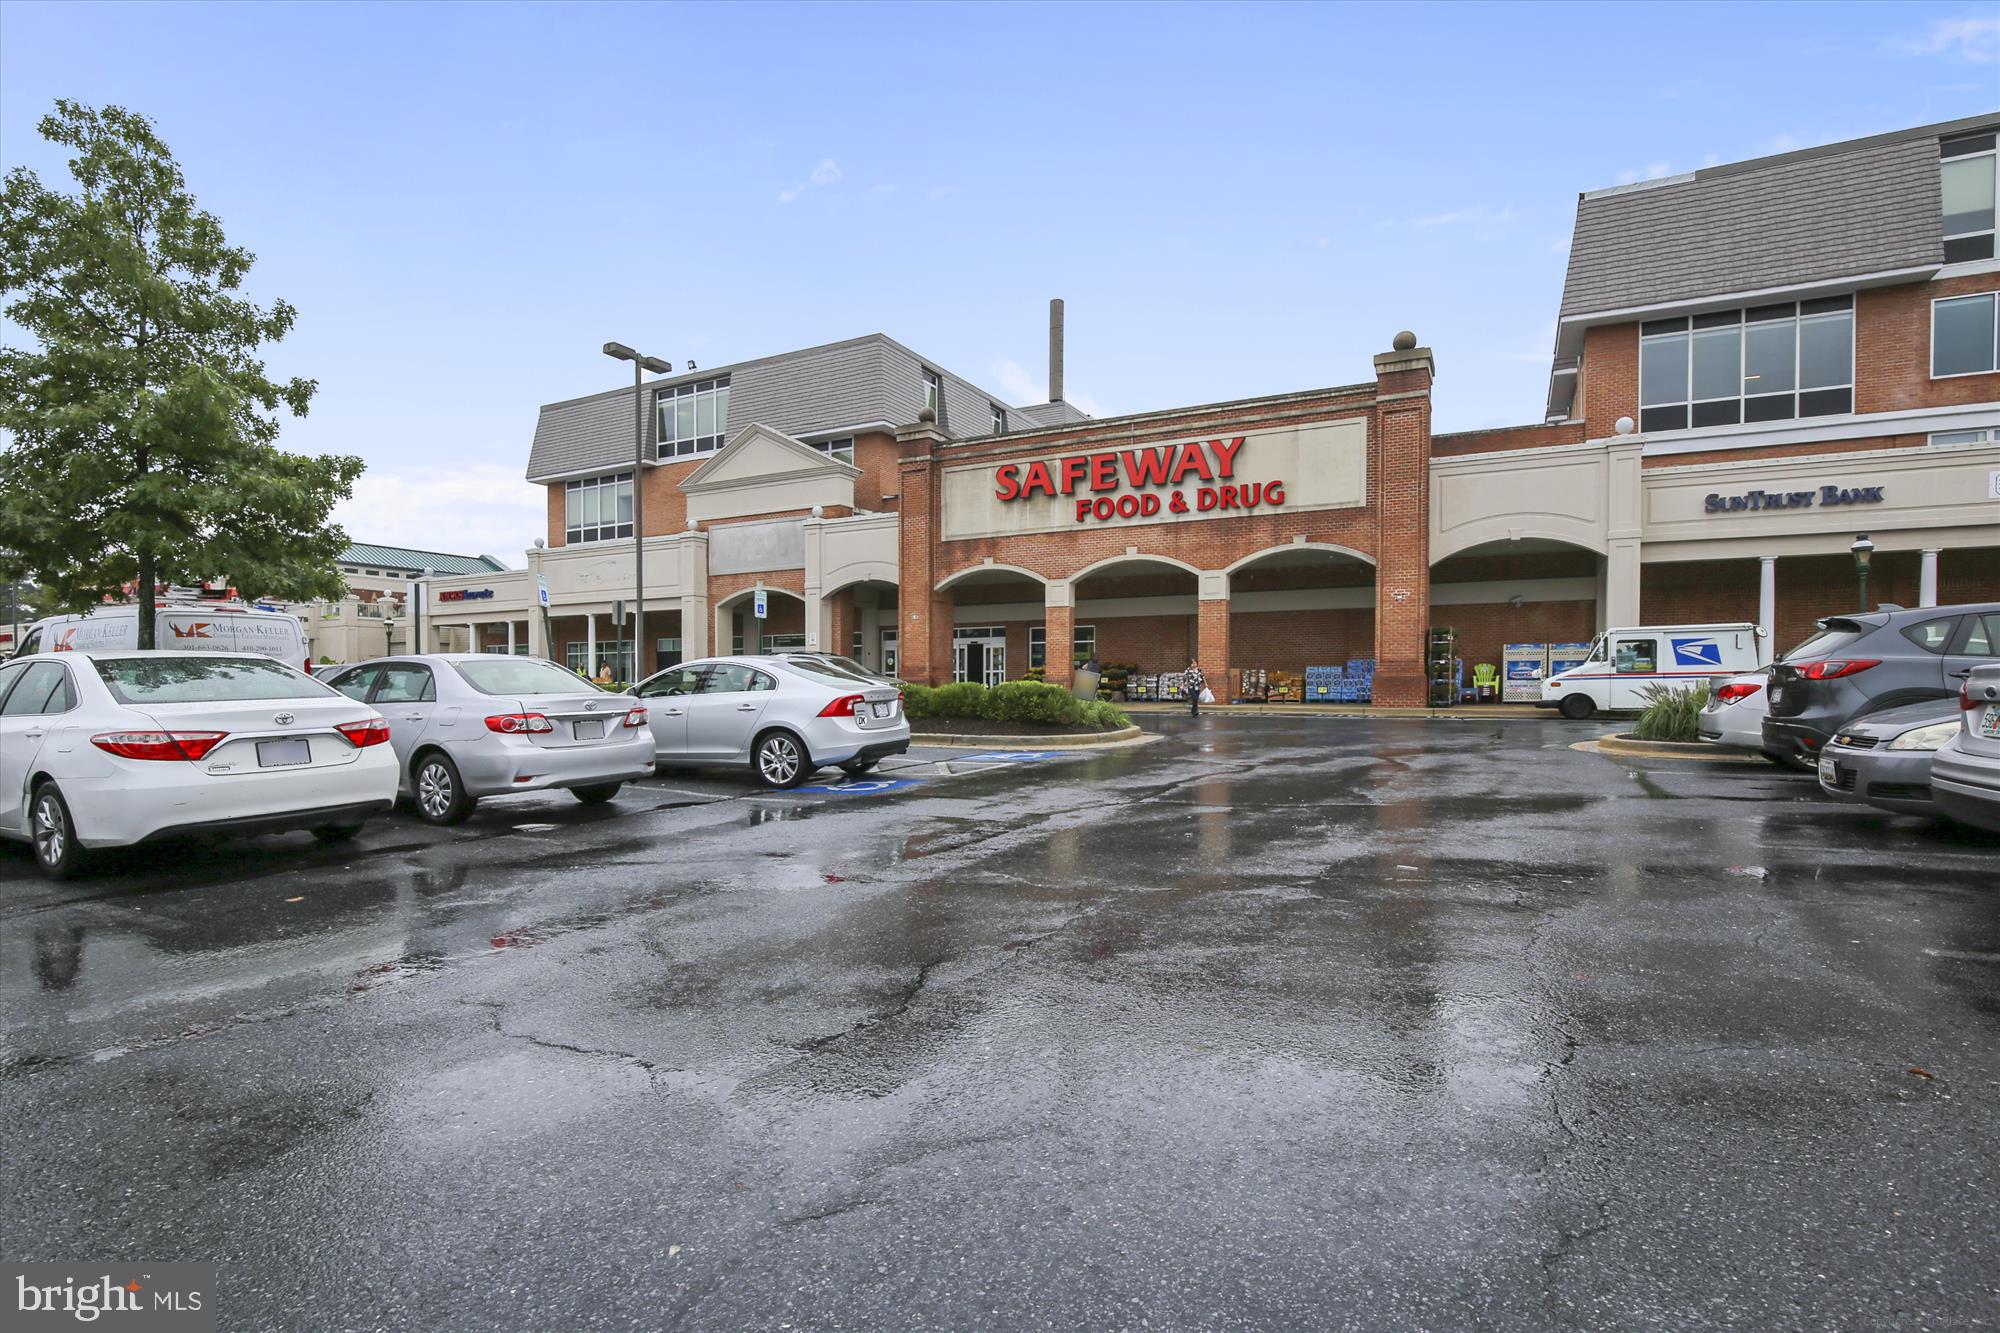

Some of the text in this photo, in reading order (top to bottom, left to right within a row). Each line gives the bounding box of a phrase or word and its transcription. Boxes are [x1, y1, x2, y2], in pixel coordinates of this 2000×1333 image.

[995, 436, 1246, 501] SAFEWAY
[1076, 479, 1286, 522] FOOD & DRUG
